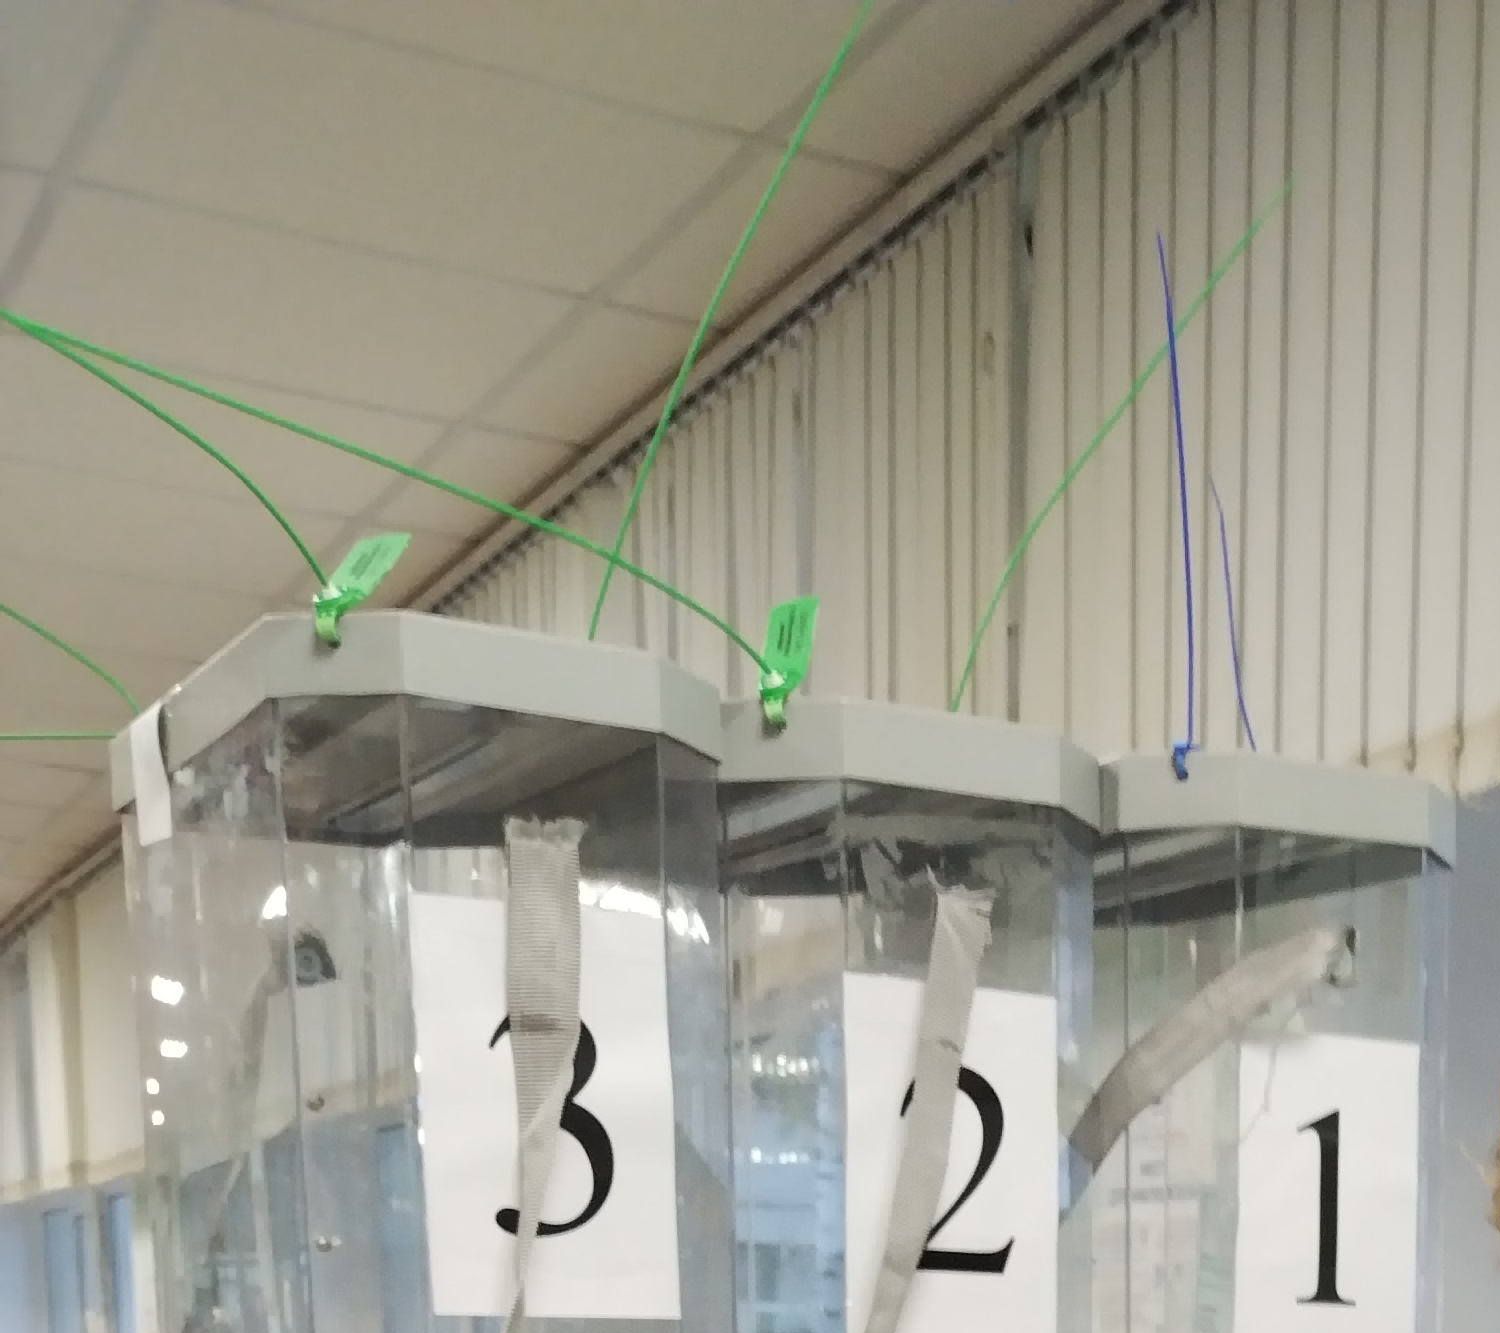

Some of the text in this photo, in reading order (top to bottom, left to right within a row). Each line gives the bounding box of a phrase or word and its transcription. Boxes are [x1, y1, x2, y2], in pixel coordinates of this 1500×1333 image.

[489, 1009, 614, 1238] 3
[899, 1065, 1015, 1274] 2
[1296, 1108, 1357, 1307] 1
